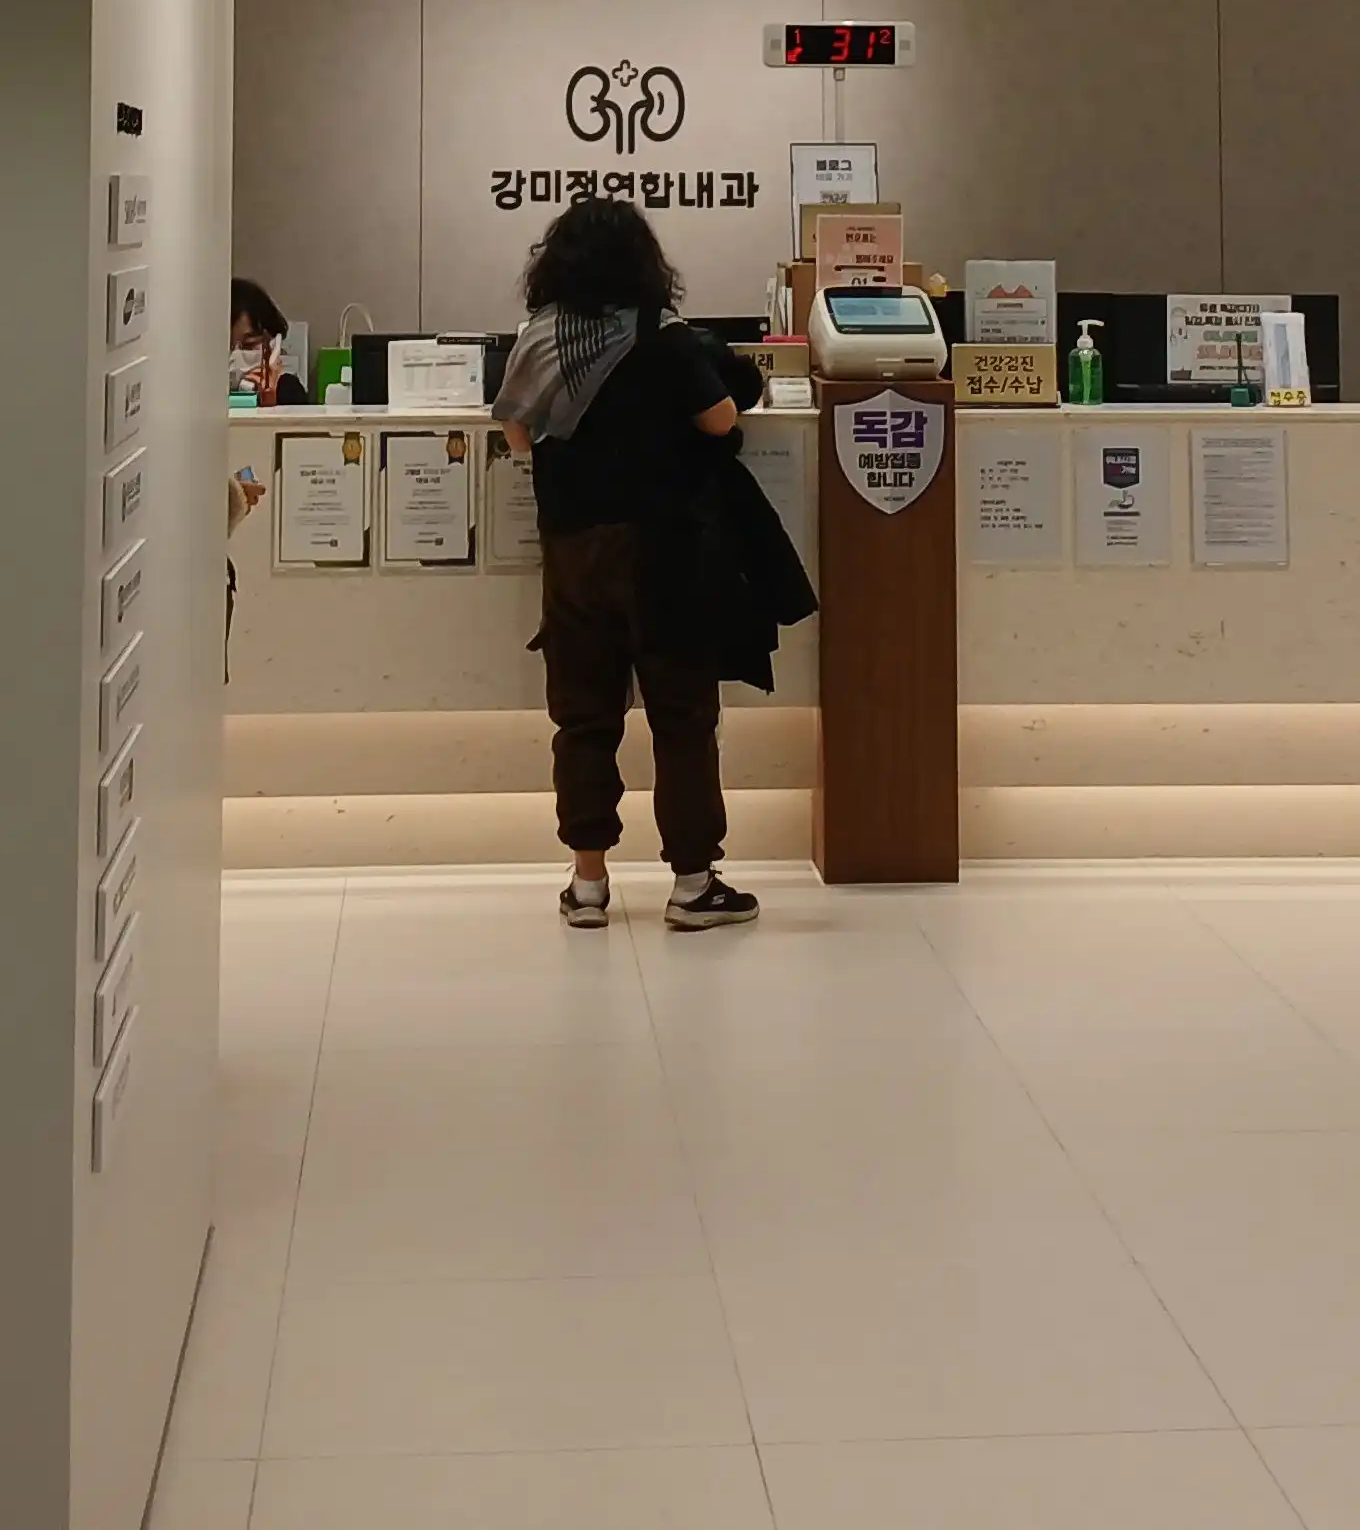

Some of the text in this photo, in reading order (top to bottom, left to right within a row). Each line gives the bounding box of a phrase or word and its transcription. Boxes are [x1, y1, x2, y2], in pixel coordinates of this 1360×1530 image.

[830, 28, 876, 61] 31
[879, 29, 891, 44] 2
[491, 170, 759, 210] 강미정연합내과
[974, 355, 1034, 372] 건강검진
[966, 376, 1043, 395] 접수/수납
[853, 411, 928, 449] 독감
[867, 471, 915, 488] 합니다
